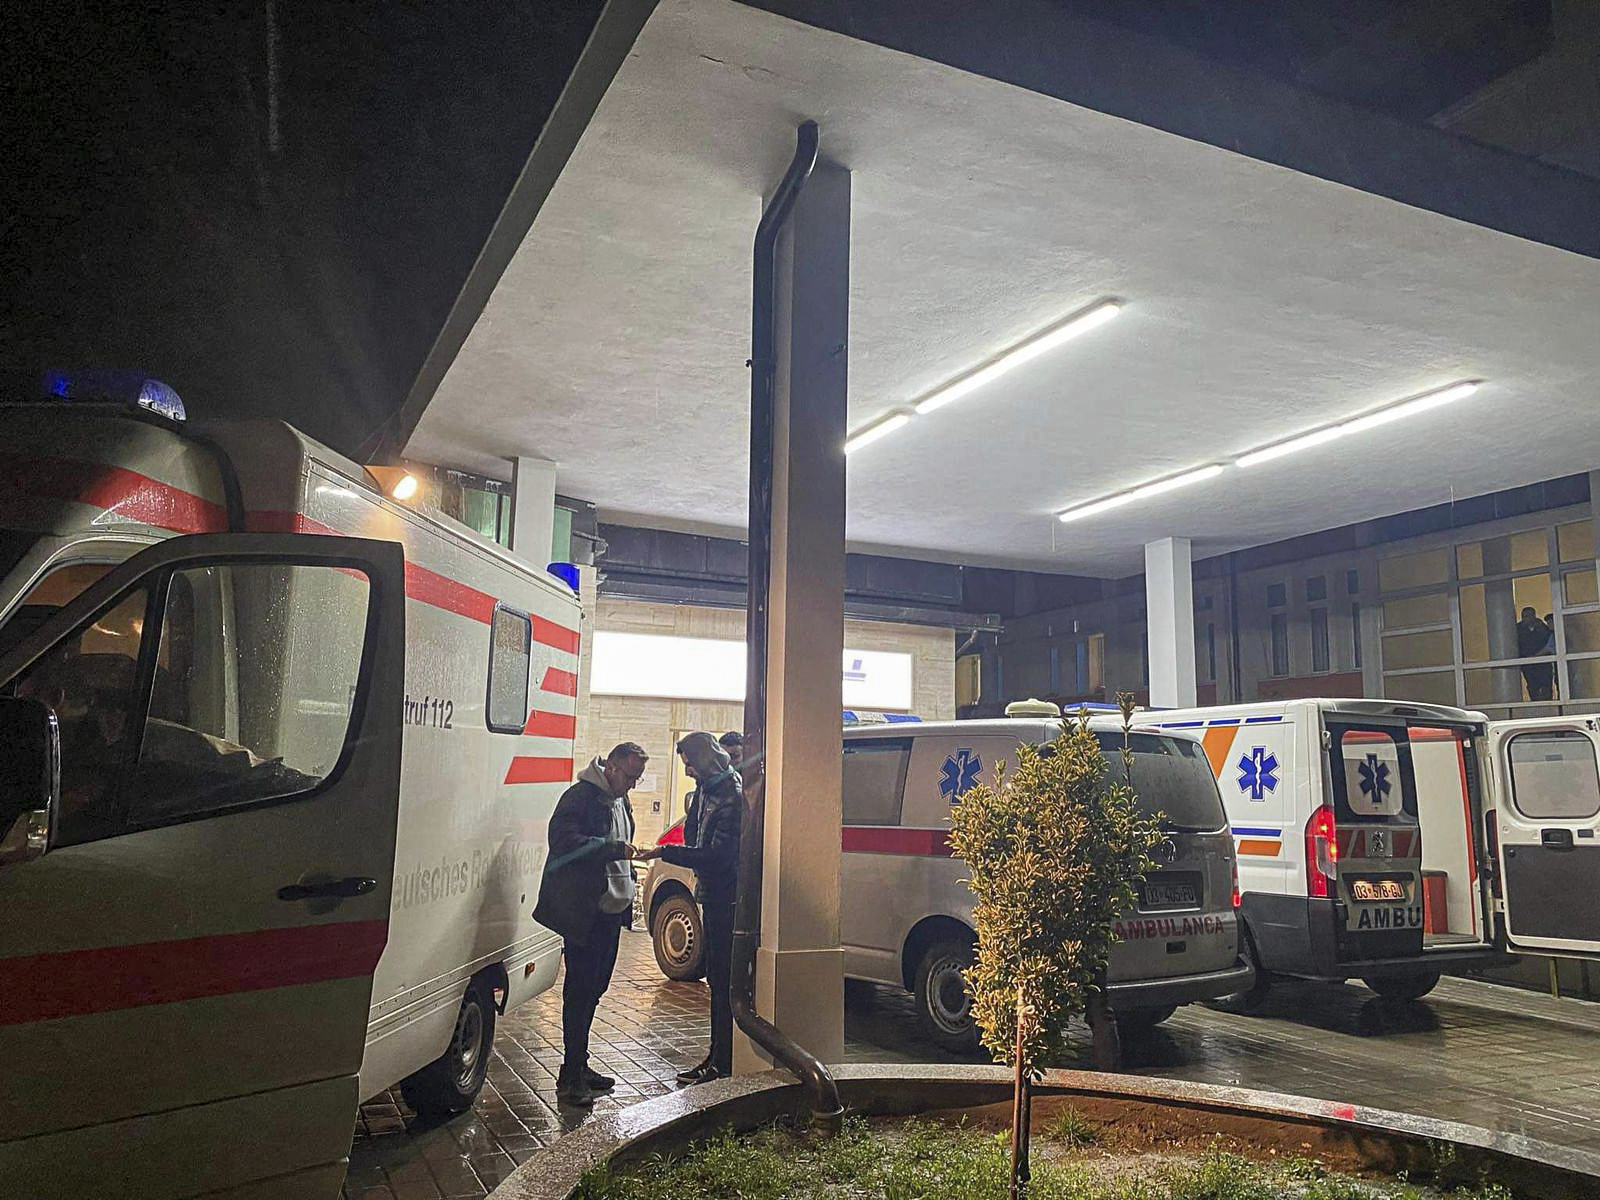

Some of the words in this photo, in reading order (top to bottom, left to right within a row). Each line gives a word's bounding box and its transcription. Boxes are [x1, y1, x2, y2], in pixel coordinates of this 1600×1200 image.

[431, 698, 453, 729] 112
[1114, 915, 1225, 940] AMBULANCA
[1357, 906, 1421, 929] AMBU
